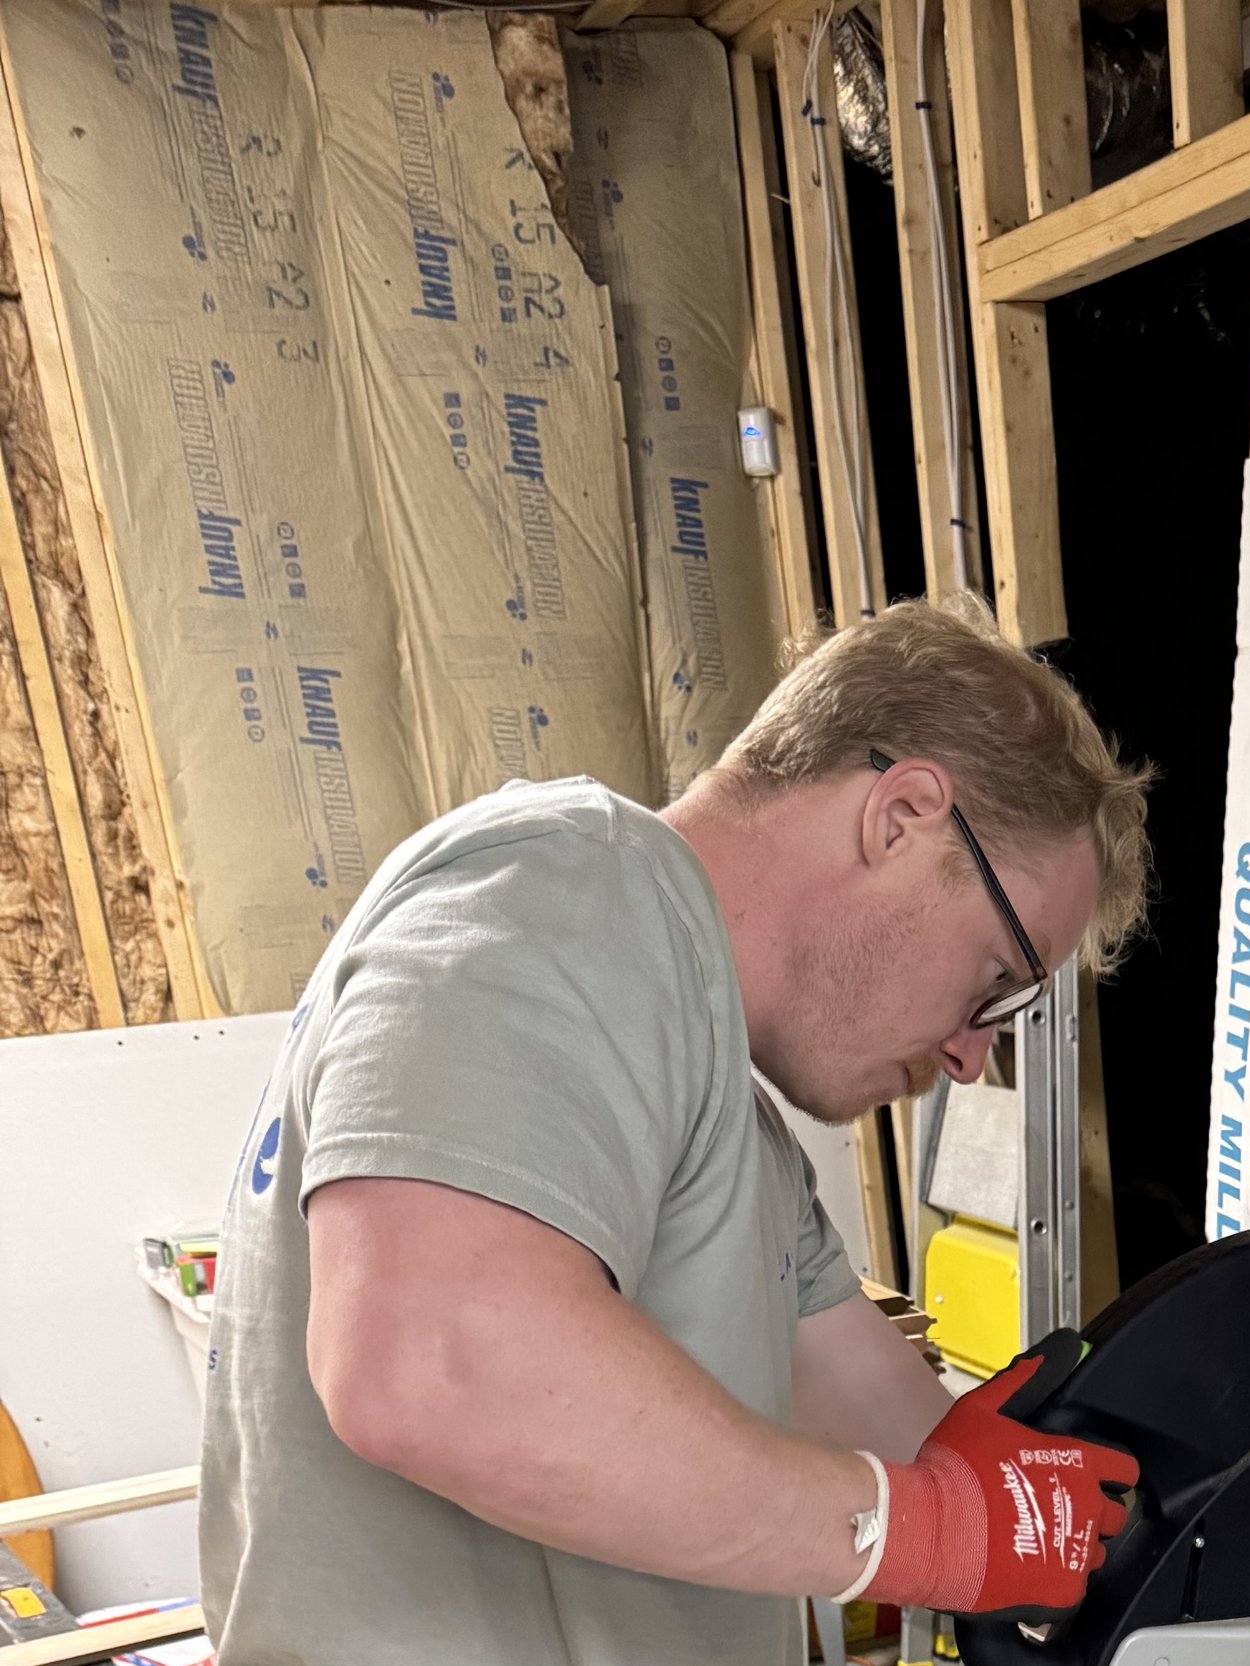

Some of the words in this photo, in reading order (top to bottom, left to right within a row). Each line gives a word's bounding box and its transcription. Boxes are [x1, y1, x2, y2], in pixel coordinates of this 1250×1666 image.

[998, 1461, 1040, 1563] Milwaukee
[1052, 1487, 1063, 1523] LEVEL
[1052, 1525, 1064, 1548] CUT
